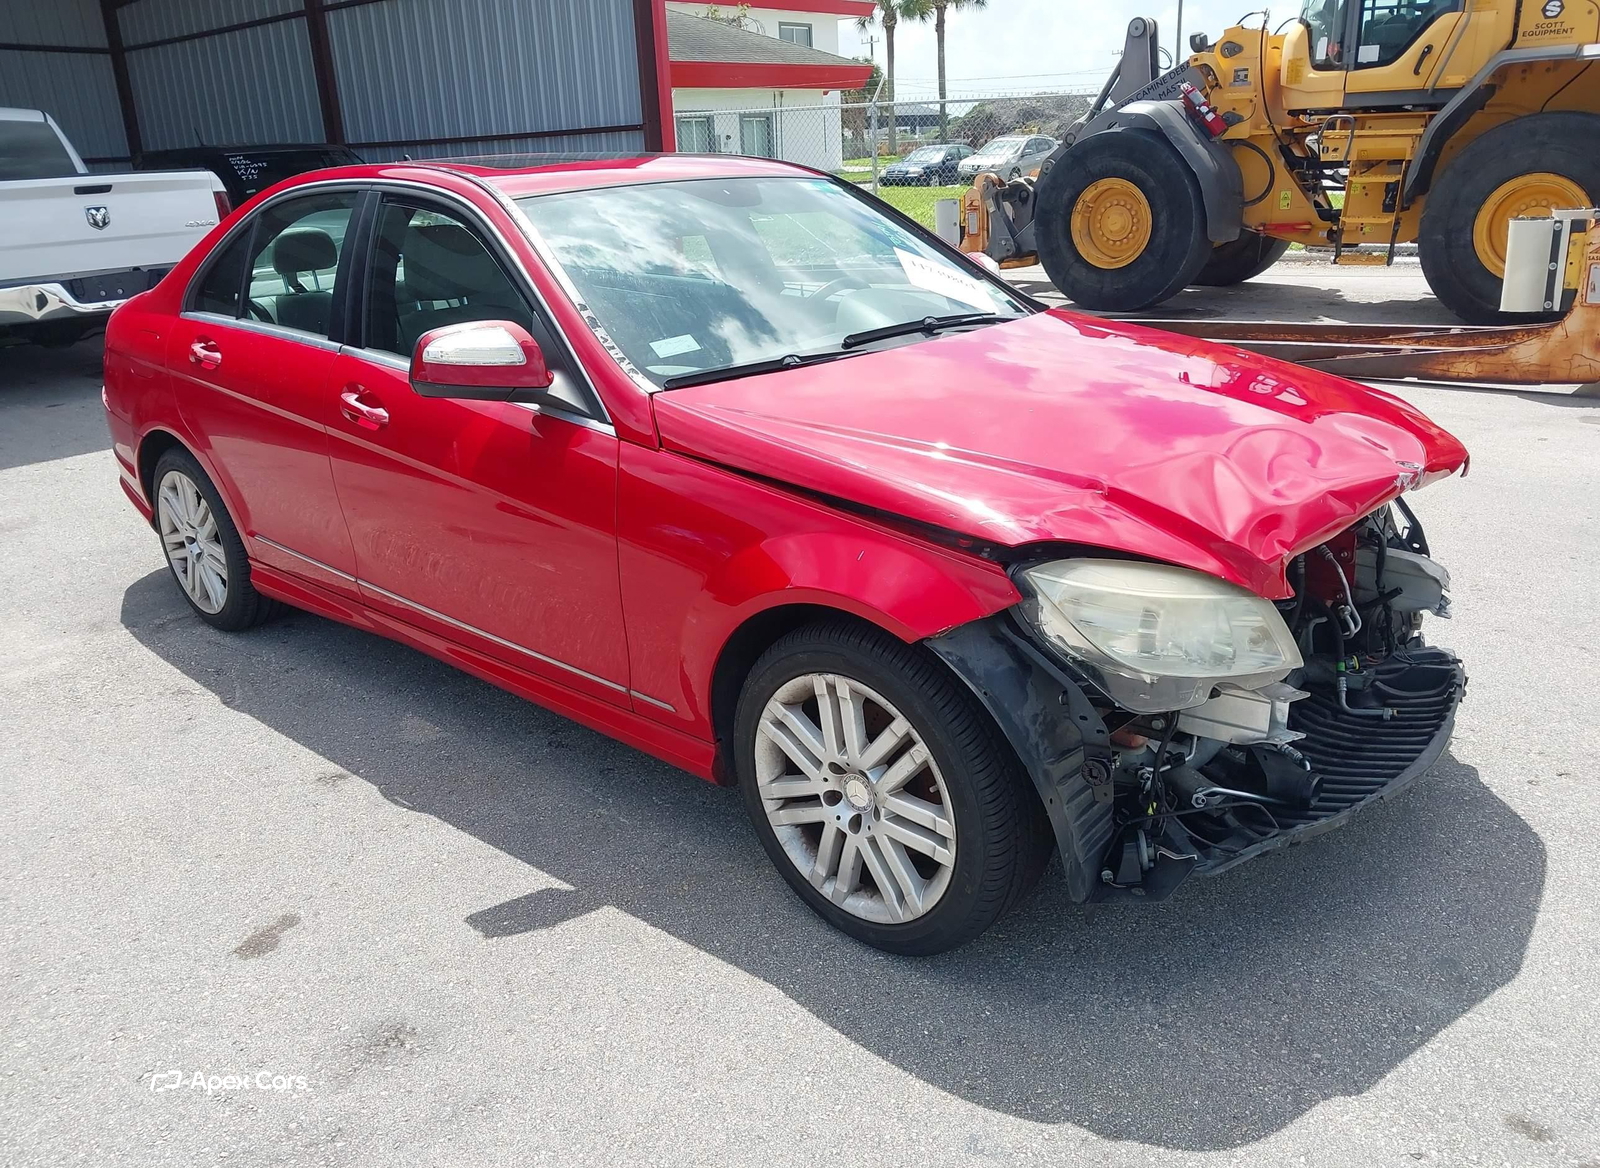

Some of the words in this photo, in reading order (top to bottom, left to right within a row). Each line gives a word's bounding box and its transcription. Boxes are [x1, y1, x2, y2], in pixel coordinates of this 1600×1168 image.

[1535, 21, 1565, 30] SCOTT
[1522, 27, 1575, 38] EQUIPMENT
[1136, 78, 1168, 101] CAMINE
